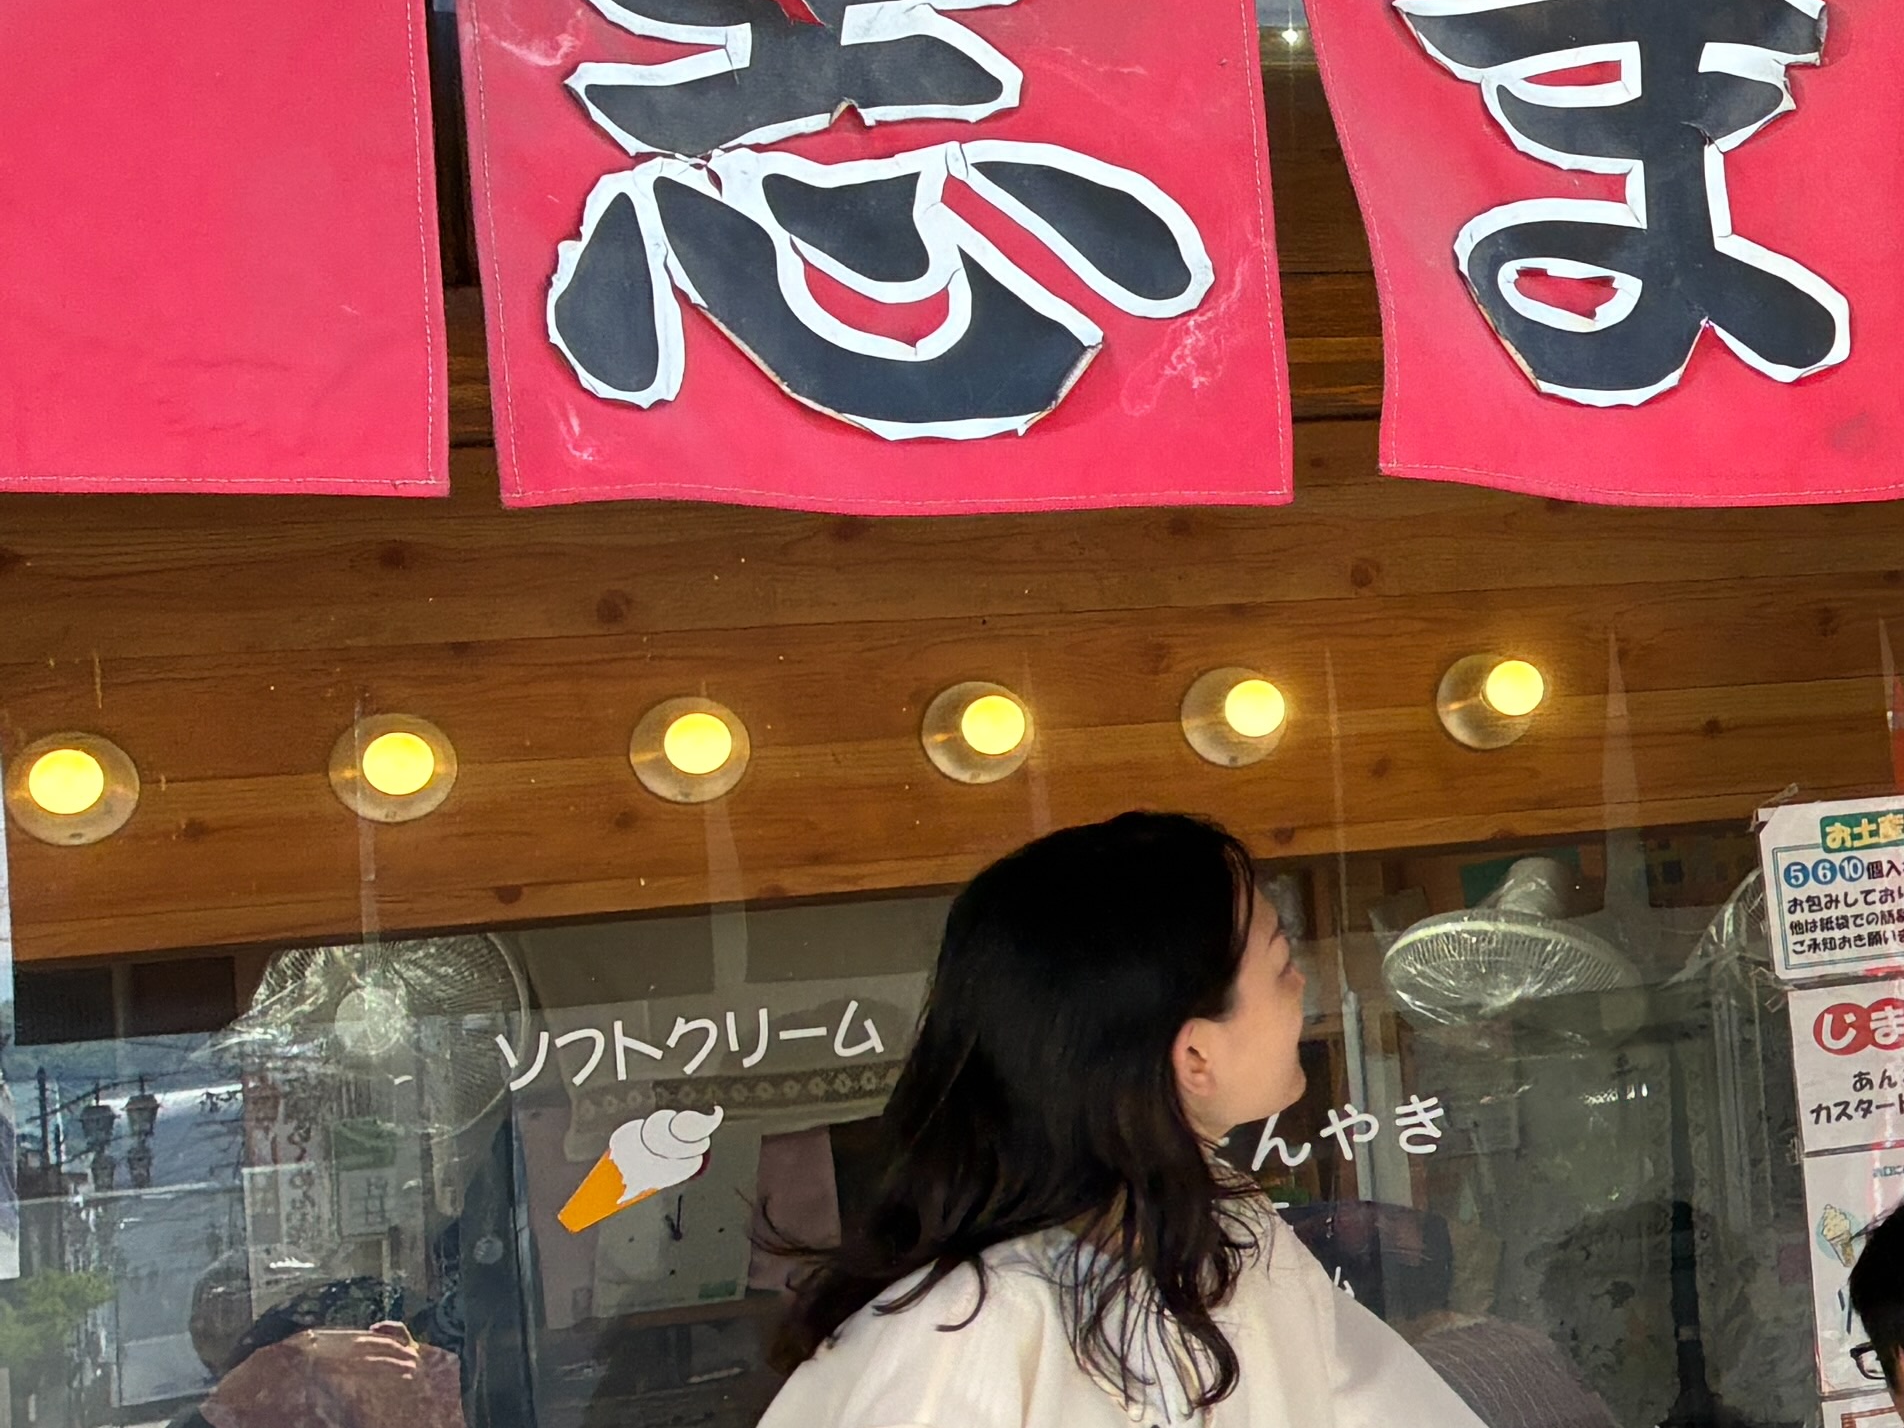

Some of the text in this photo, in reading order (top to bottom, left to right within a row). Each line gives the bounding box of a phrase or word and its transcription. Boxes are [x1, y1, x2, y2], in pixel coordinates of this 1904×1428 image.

[492, 999, 886, 1093] ソフトクリーム
[1216, 1094, 1445, 1172] んやき
